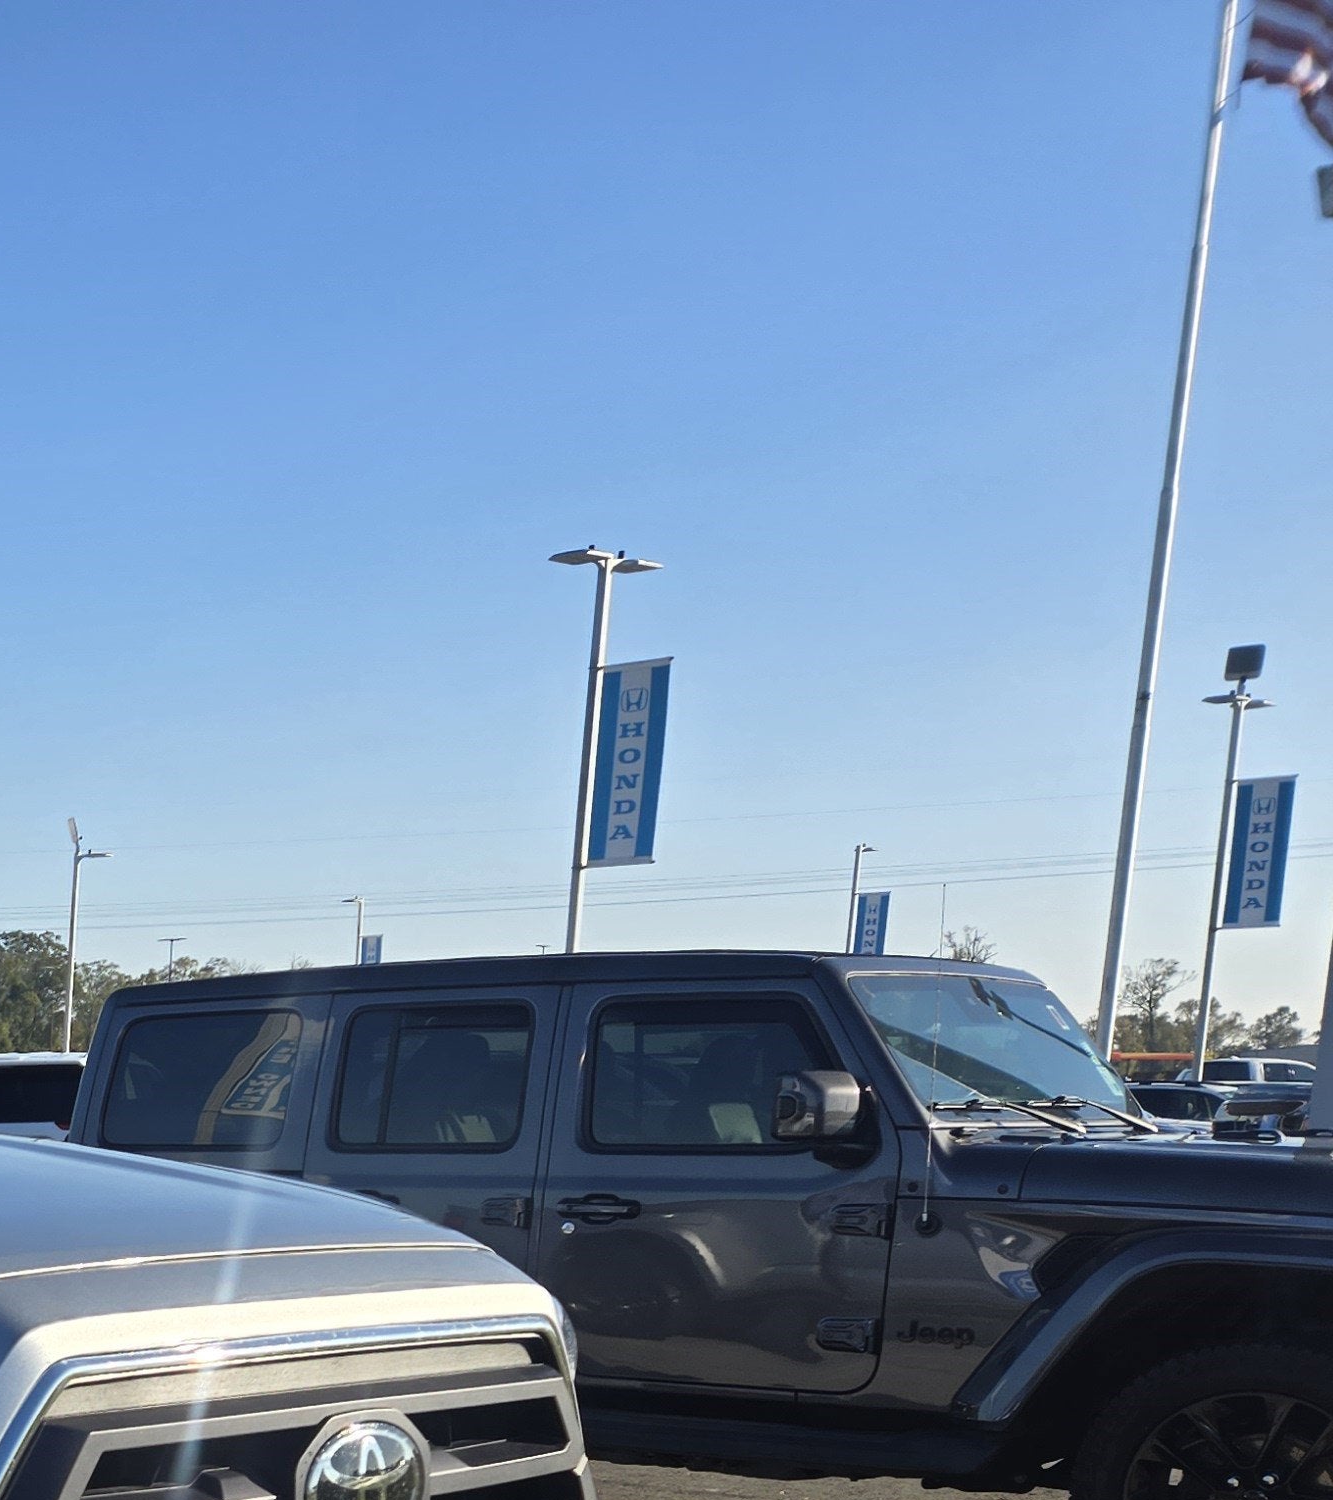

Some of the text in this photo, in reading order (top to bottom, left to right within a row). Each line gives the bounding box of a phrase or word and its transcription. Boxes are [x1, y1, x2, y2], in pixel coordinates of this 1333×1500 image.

[609, 721, 646, 840] HONDA
[1242, 822, 1273, 909] HONDA
[864, 918, 876, 954] HON
[896, 1320, 976, 1350] Jeep
